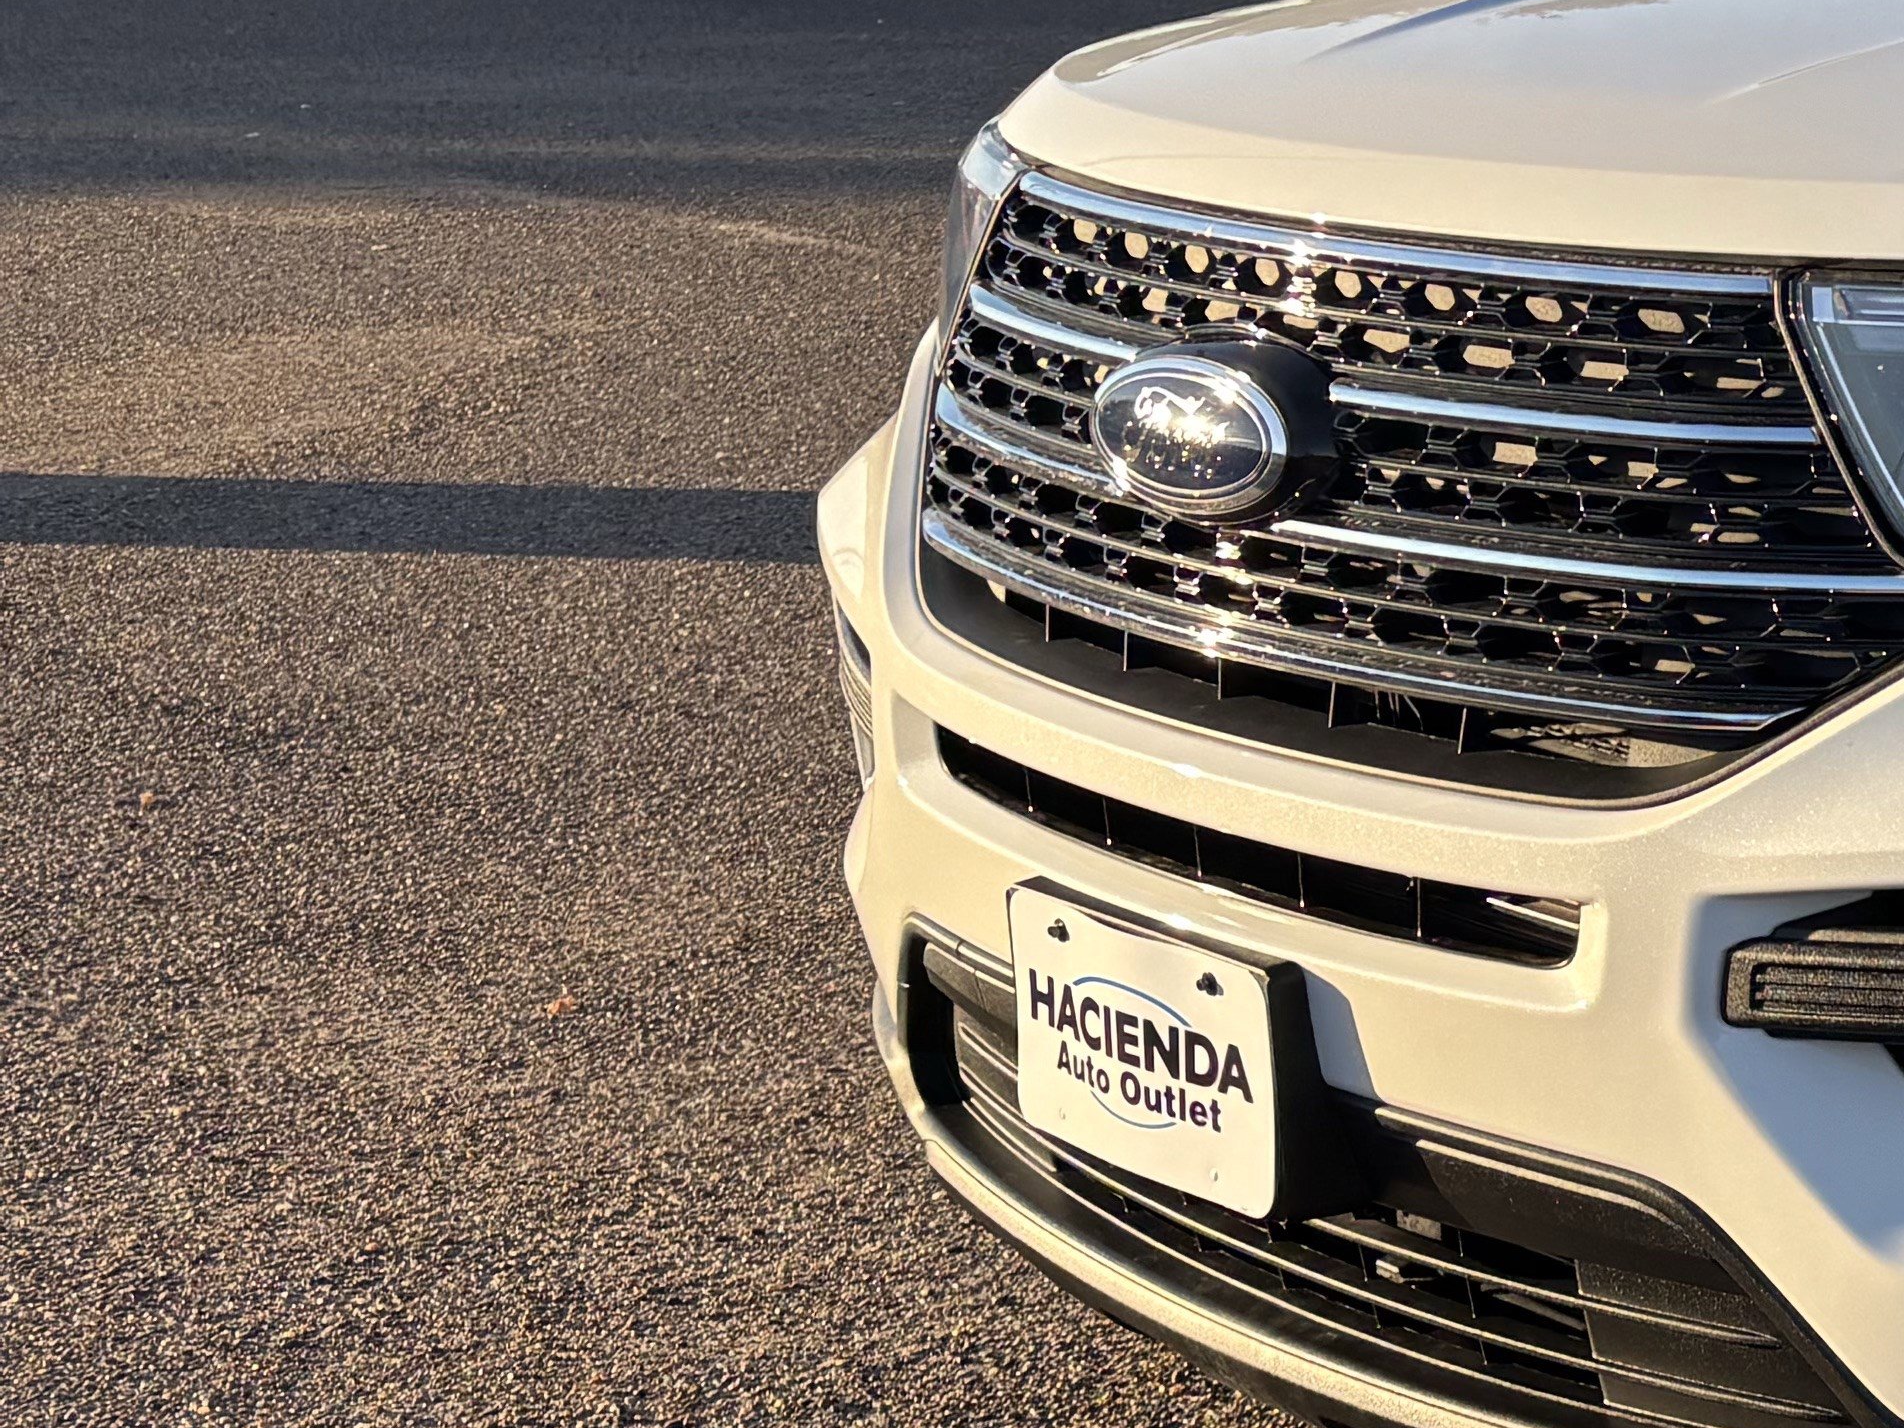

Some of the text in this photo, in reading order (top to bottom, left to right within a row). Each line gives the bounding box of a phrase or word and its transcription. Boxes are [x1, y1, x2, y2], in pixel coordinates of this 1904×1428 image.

[1027, 967, 1254, 1104] HACIENDA
[1056, 1040, 1223, 1134] Auto Outlet
